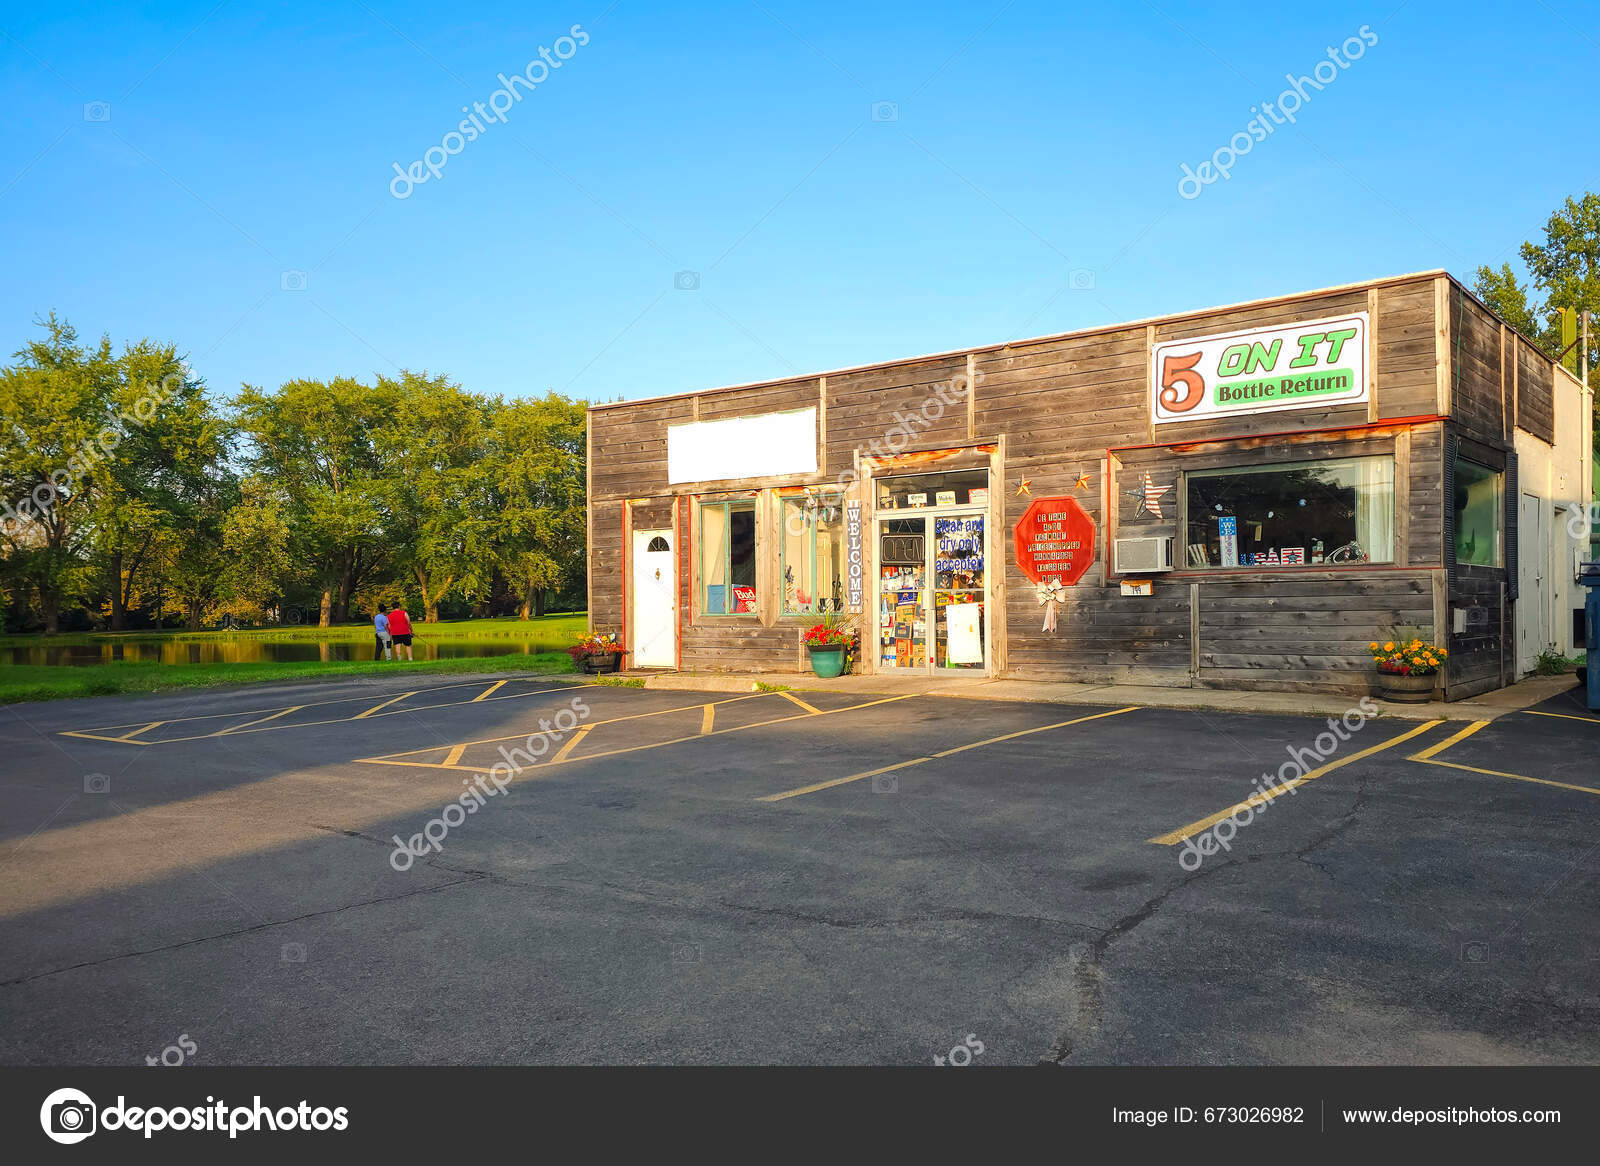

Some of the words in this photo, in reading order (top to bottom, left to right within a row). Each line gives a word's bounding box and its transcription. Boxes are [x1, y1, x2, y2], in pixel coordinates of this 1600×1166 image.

[1159, 351, 1206, 413] 5
[1217, 338, 1283, 378] ON
[1289, 327, 1358, 369] IT
[1219, 382, 1275, 402] Bottle
[1280, 374, 1347, 395] Return
[936, 517, 963, 534] clean
[966, 515, 985, 533] and
[883, 537, 923, 561] OPEN
[939, 535, 956, 555] dry
[958, 534, 980, 554] only
[847, 508, 862, 605] WELCOME
[935, 555, 985, 574] accepted
[1239, 551, 1281, 566] USA
[734, 588, 756, 599] Bud
